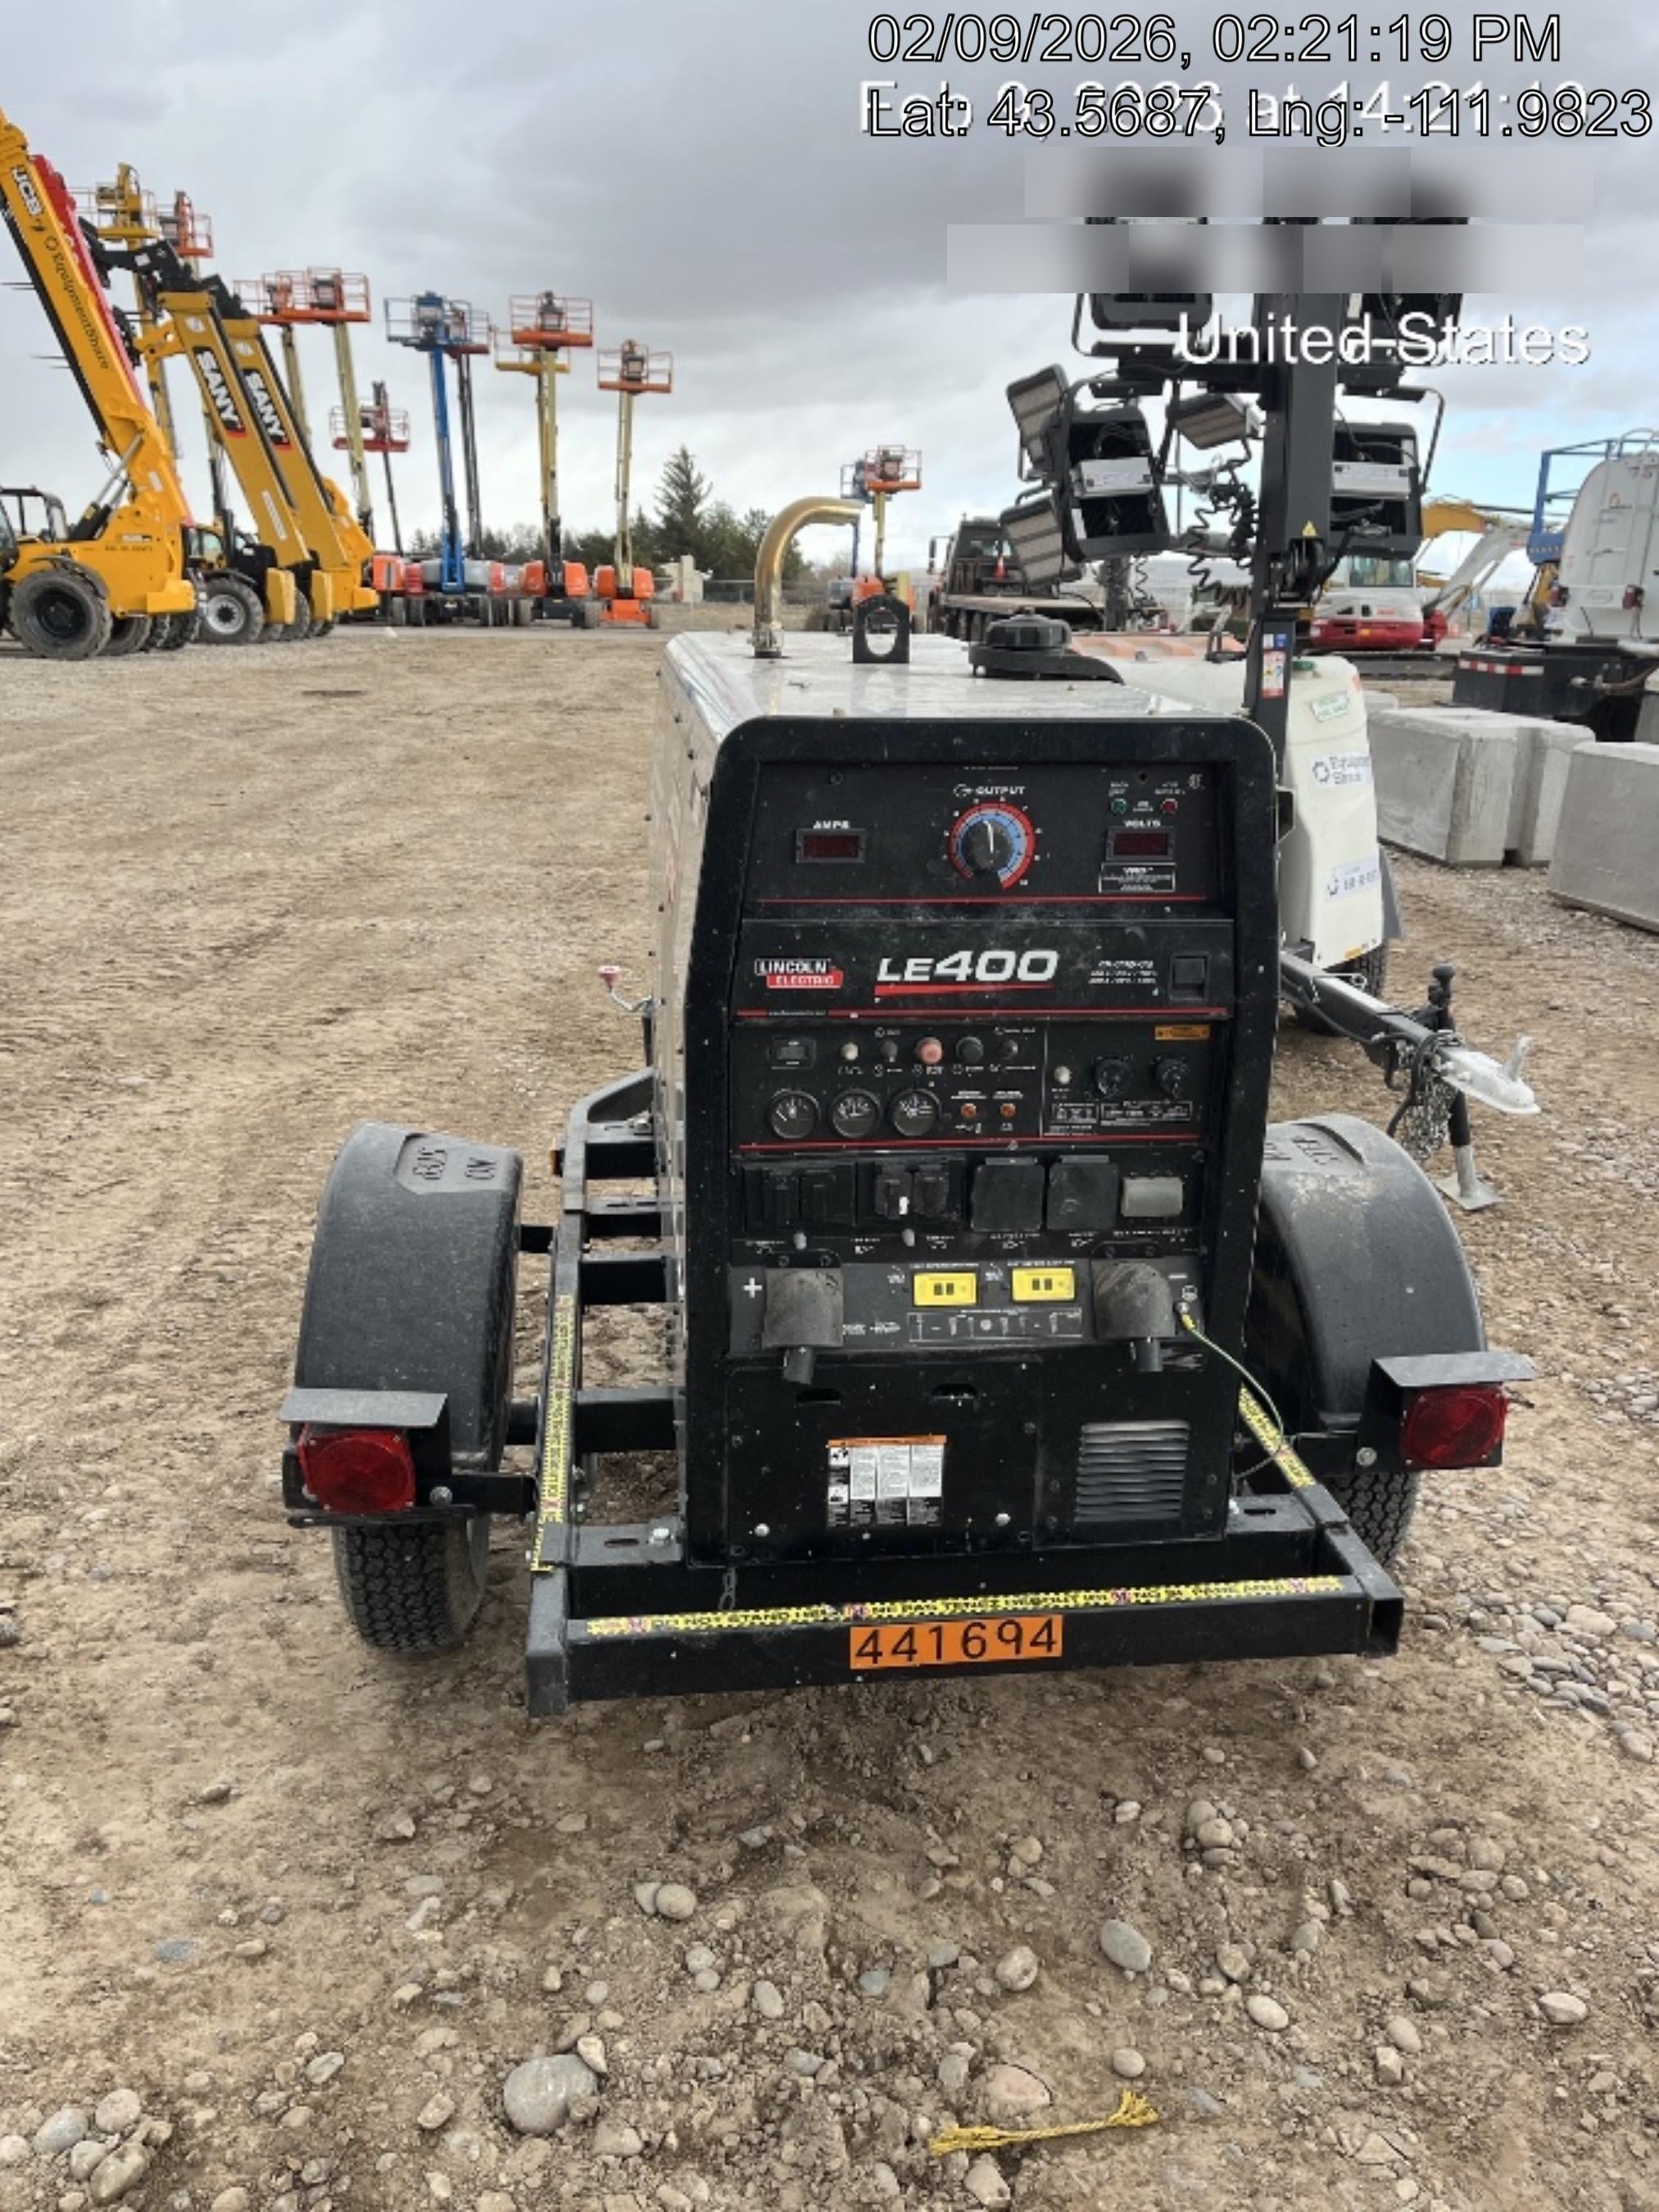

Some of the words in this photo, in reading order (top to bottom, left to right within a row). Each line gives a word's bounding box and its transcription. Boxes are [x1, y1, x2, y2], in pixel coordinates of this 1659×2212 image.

[11, 164, 43, 218] JCB
[196, 351, 238, 424] SANY
[245, 369, 285, 438] SANY
[759, 959, 827, 974] LINCOLN
[776, 975, 835, 986] ELECTRIC
[877, 950, 1059, 981] LE400
[854, 1617, 1057, 1666] 441694
